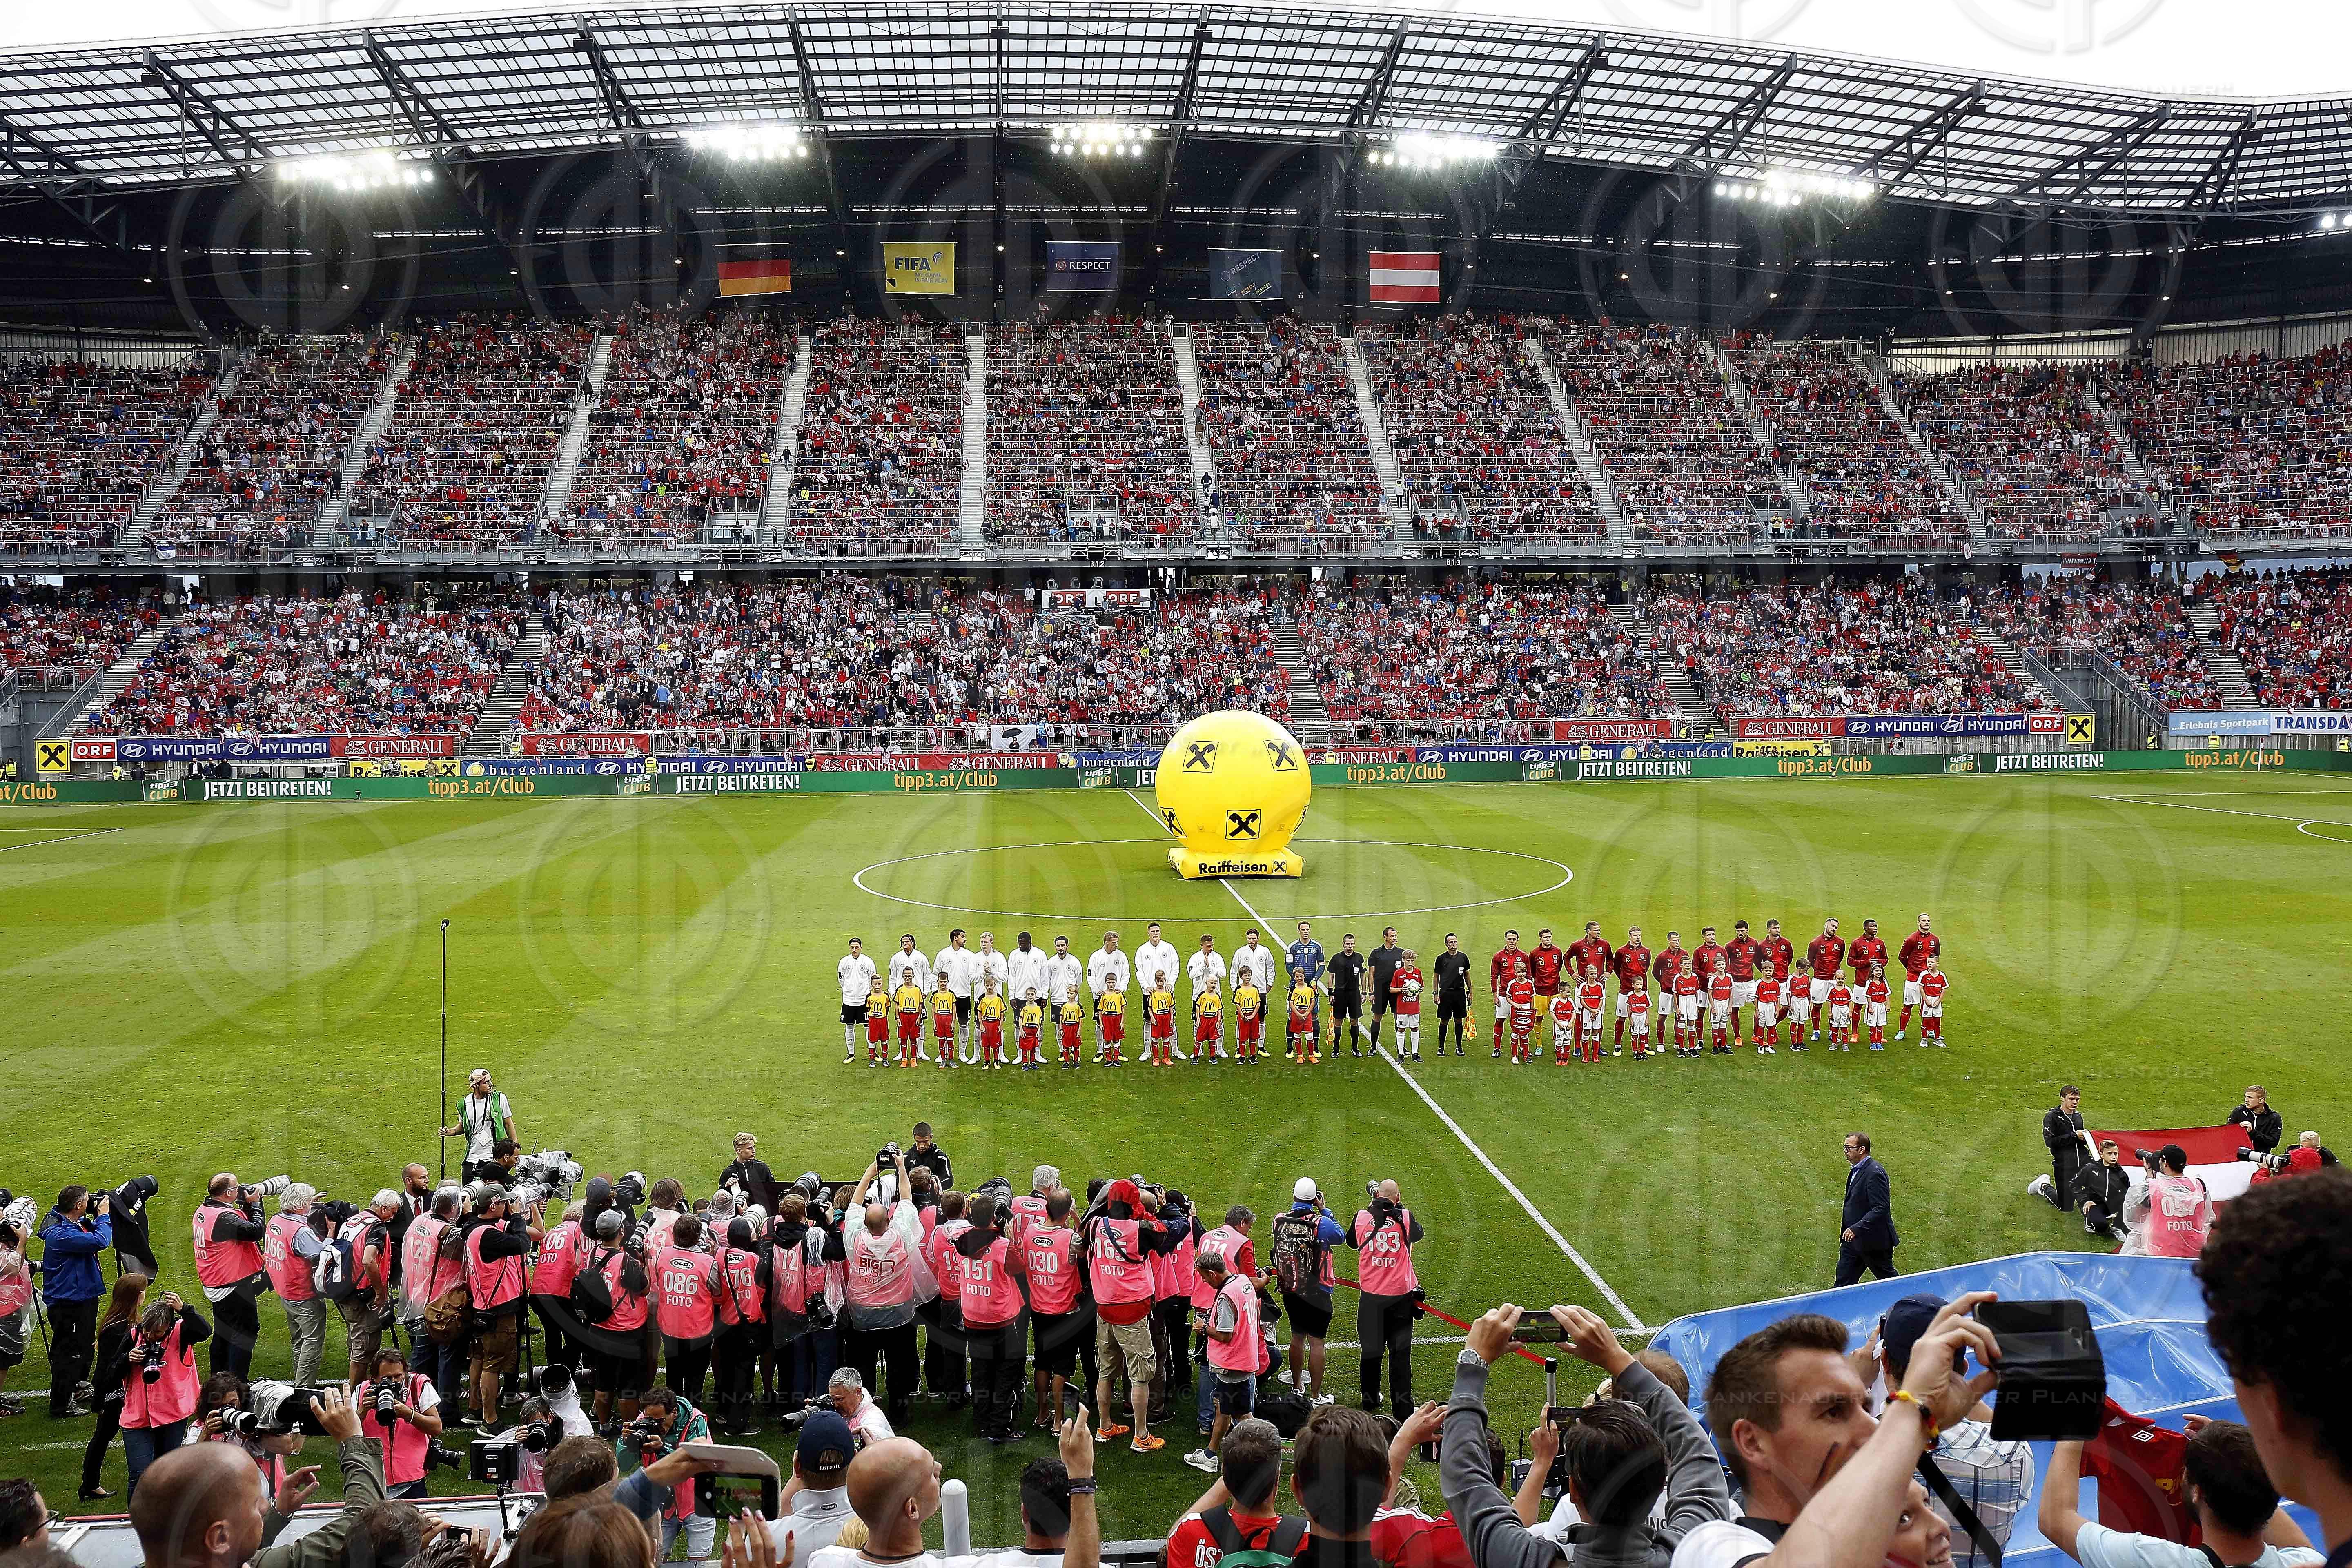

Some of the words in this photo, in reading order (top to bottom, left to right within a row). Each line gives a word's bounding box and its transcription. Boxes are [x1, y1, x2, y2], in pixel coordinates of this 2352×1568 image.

[894, 257, 931, 271] FIFA
[1069, 261, 1111, 270] RESPECT
[1230, 252, 1260, 275] RESPECT
[1766, 722, 1833, 735] GENERALI
[1875, 721, 1934, 732] HYUNDAI
[1968, 719, 2025, 731] HYUNDAI
[2033, 719, 2062, 730] ORF
[2220, 717, 2269, 730] Sportpark
[1589, 723, 1657, 738] GENERALI
[76, 745, 113, 756] ORF
[151, 744, 221, 755] HYUNDAI
[258, 742, 327, 755] HYUNDAI
[368, 739, 443, 754] GENERALI
[971, 755, 1046, 770] GENERALI
[1082, 754, 1150, 768] burgenland
[1448, 750, 1512, 762] HYUNDAI
[1949, 754, 1973, 763] tipp3
[489, 762, 585, 776] burgenland
[1529, 761, 1555, 770] tipp3
[1949, 762, 1973, 773] CLUB
[1994, 755, 2029, 773] JETZT
[2031, 753, 2104, 769] BEITRETEN!
[1084, 767, 1111, 777] tipp3
[1347, 763, 1447, 784] tipp3.at/Club
[1529, 769, 1554, 780] CLUB
[1577, 761, 1612, 780] JETZT
[1616, 760, 1691, 776] BEITRETEN!
[623, 774, 652, 784] tipp3
[675, 775, 714, 794] JETZT
[717, 774, 800, 791] BEITRETEN!
[894, 771, 998, 791] tipp3.at/Club
[1084, 775, 1111, 787] CLUB
[1135, 768, 1158, 787] JET
[149, 780, 179, 790] tipp3
[204, 782, 243, 801] JETZT
[247, 777, 332, 798] BEITRETEN!
[428, 777, 535, 798] tipp3.at/Club
[623, 782, 651, 794] CLUB
[149, 788, 178, 800] CLUB
[1198, 860, 1267, 875] Raiffeisen
[2167, 1221, 2193, 1232] FOTO
[1364, 1231, 1401, 1252] 183
[1095, 1237, 1127, 1262] 165
[859, 1257, 879, 1269] BIG
[1027, 1249, 1058, 1274] 030
[1371, 1256, 1396, 1268] FOTO
[961, 1258, 993, 1281] 151
[1100, 1264, 1125, 1276] FOTO
[664, 1270, 699, 1295] 086
[1032, 1274, 1054, 1286] FOTO
[966, 1283, 991, 1297] FOTO
[666, 1294, 693, 1307] FOTO
